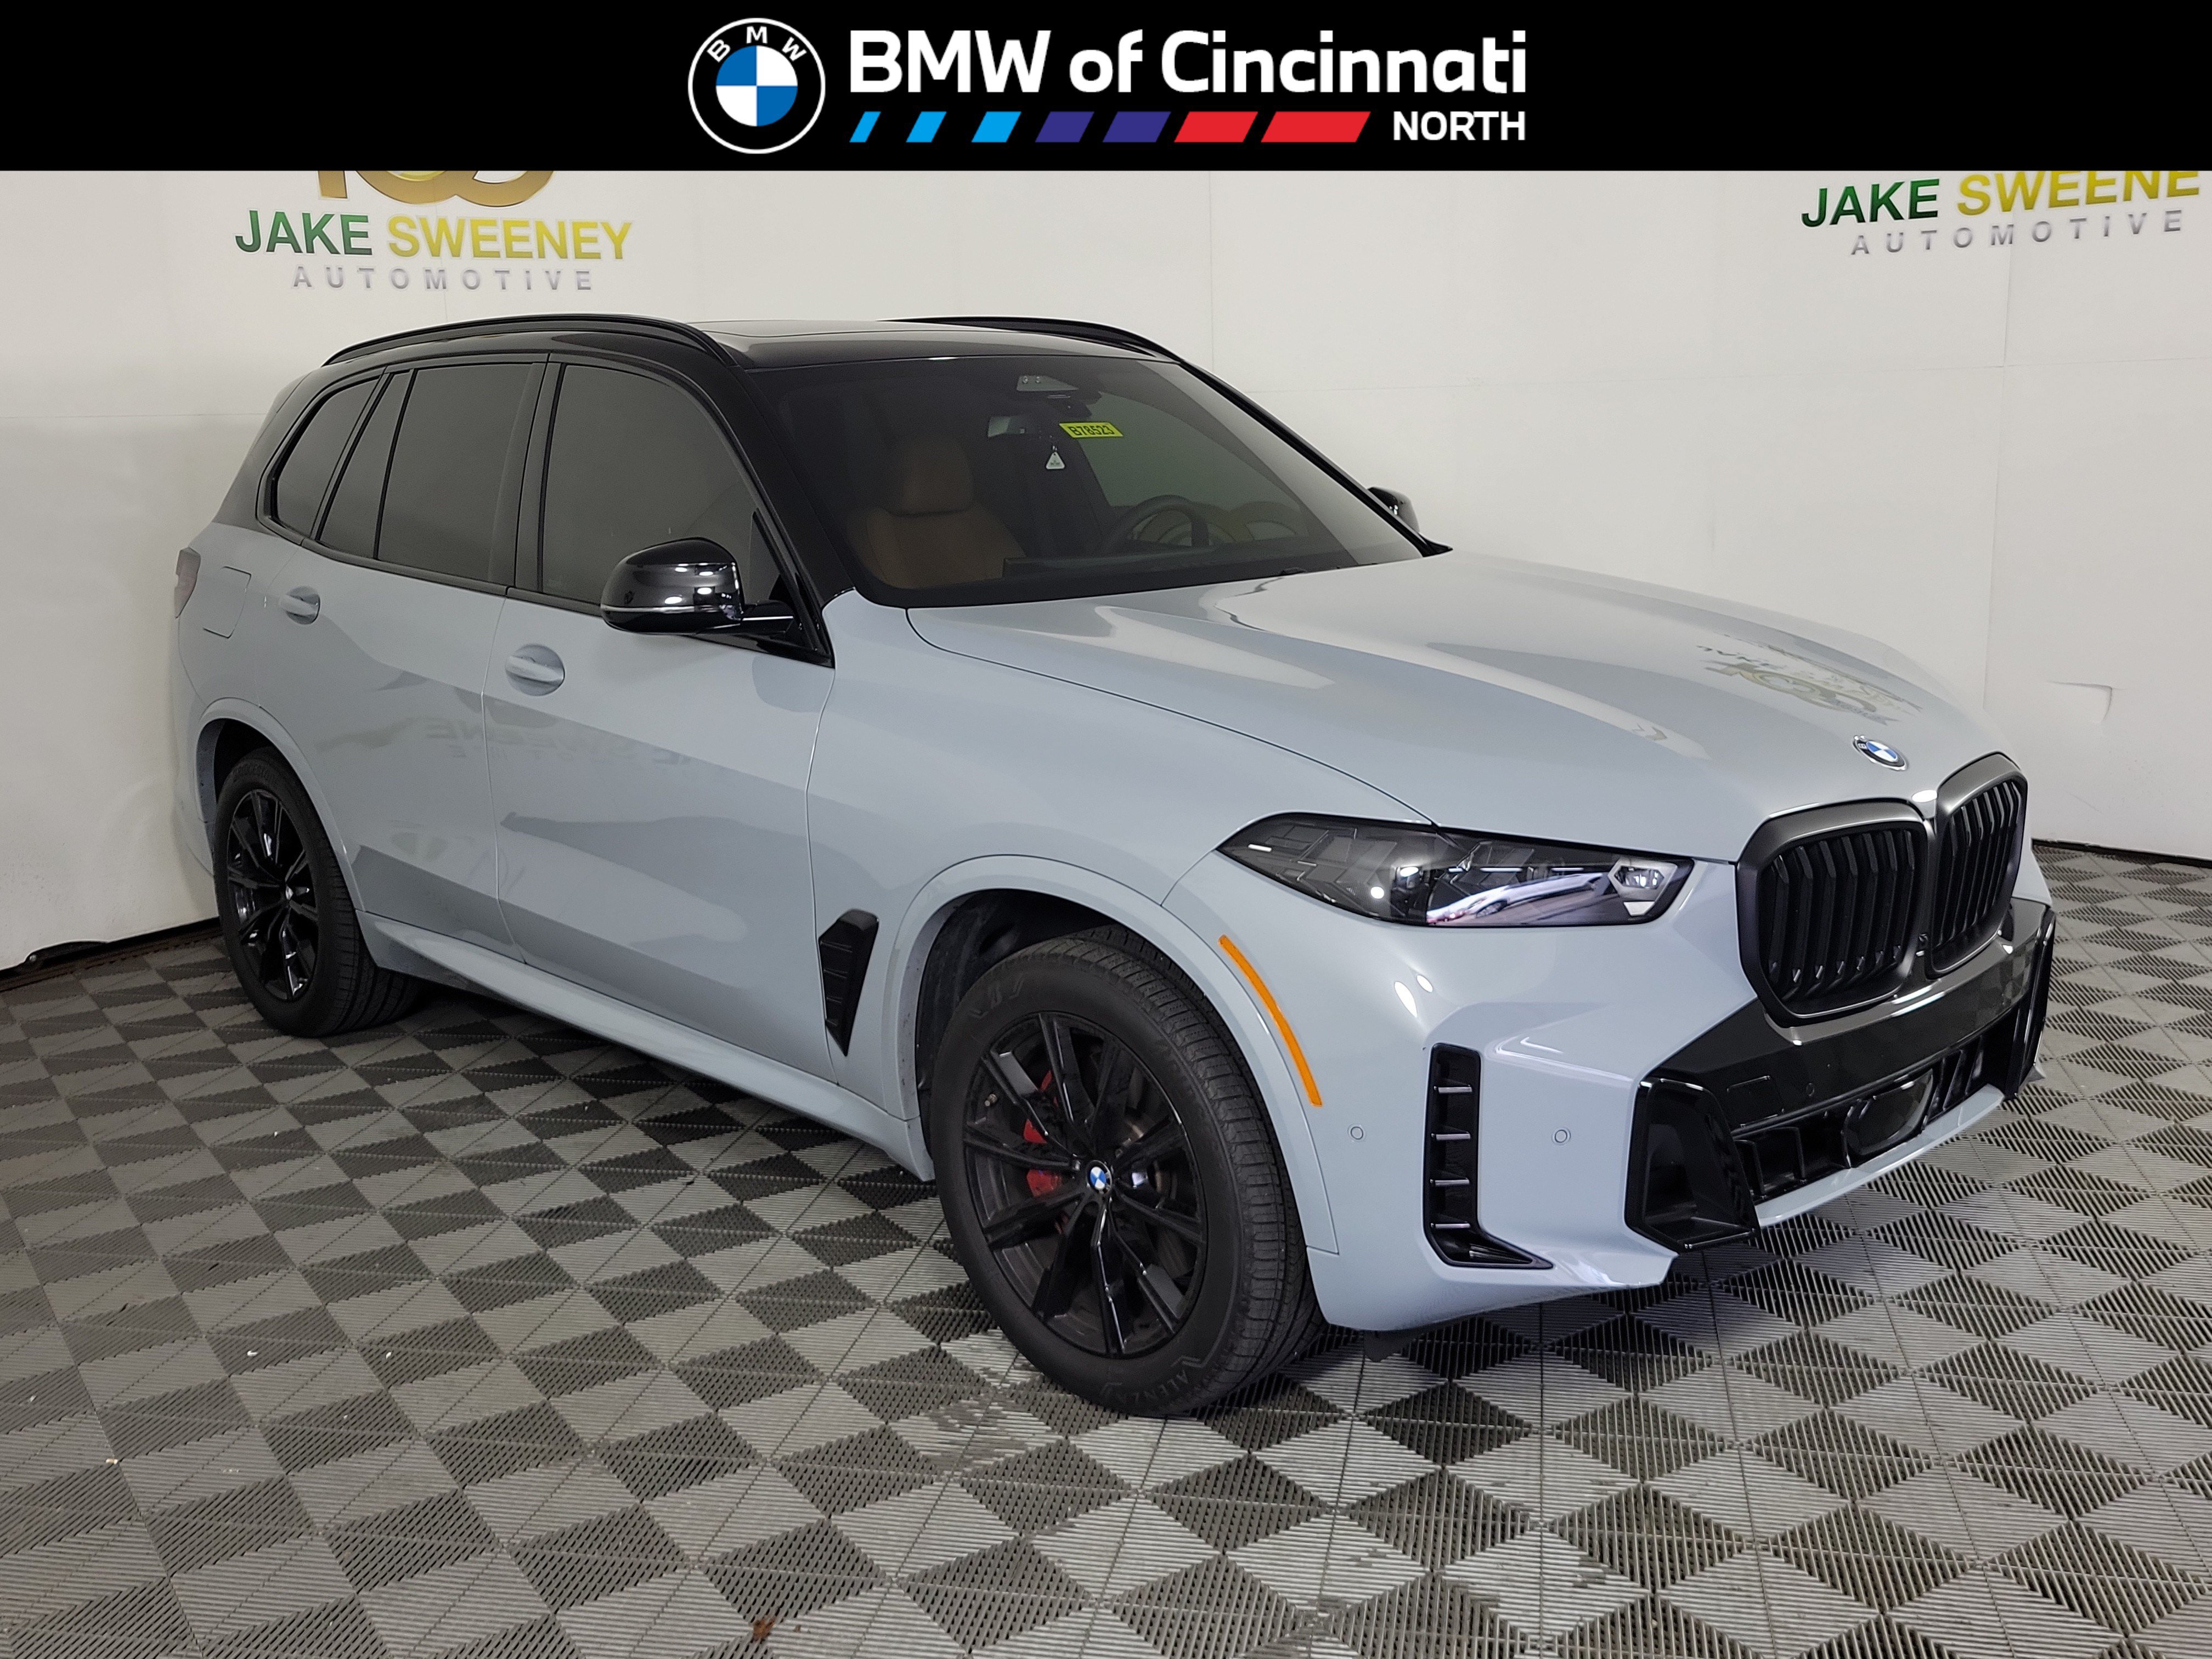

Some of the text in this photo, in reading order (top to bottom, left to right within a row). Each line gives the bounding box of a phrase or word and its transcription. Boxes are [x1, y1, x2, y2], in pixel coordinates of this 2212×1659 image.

[1801, 178, 1940, 228] JAKE
[235, 210, 632, 260] JAKE SWEENEY
[1850, 210, 2182, 255] AUTOMOTIVE
[293, 266, 592, 290] AUTOMOTIVE
[1069, 426, 1115, 436] B78523
